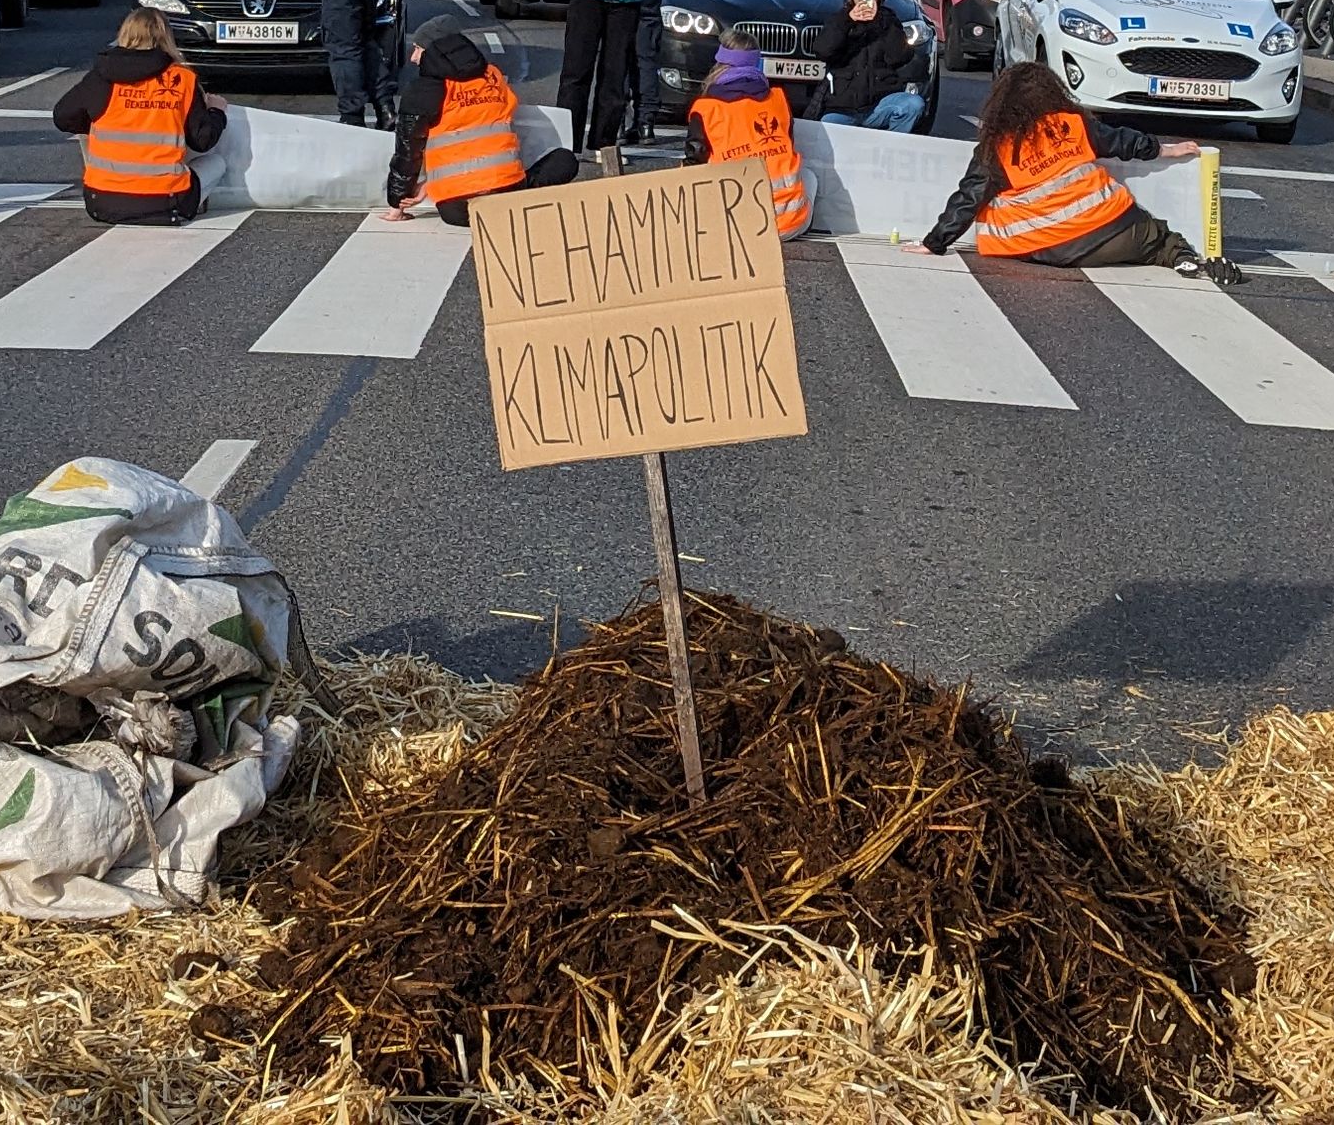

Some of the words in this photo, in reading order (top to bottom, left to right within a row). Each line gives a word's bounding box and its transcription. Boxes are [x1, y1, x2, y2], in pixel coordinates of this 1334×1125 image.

[1127, 18, 1140, 27] L
[1234, 25, 1248, 35] L
[118, 87, 148, 99] LETZTE
[721, 143, 752, 161] LETZTE
[1018, 149, 1047, 172] LETZTE
[1028, 145, 1084, 177] GENERATION.AT
[1209, 170, 1219, 225] GENERATION.AT
[1208, 227, 1218, 251] LETZTE
[497, 317, 788, 449] KLIMAPOLITIK
